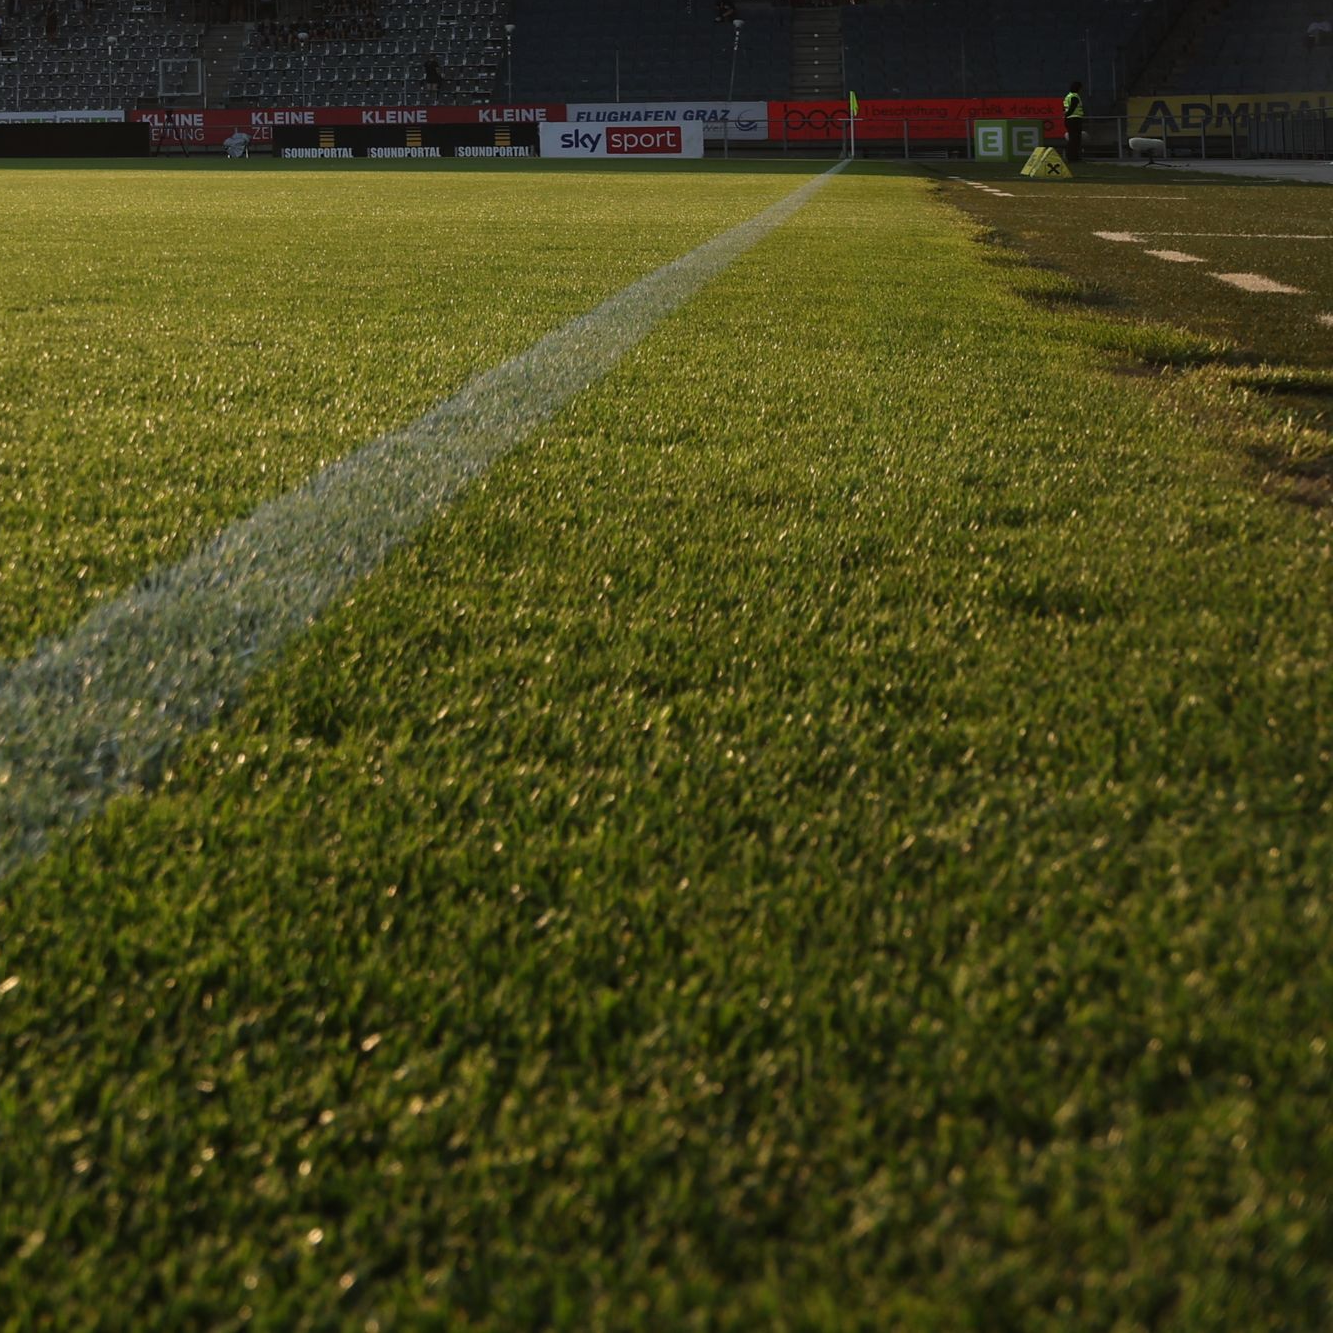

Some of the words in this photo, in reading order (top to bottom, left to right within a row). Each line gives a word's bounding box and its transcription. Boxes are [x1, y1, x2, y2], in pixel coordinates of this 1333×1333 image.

[251, 112, 315, 125] KLEINE
[362, 110, 428, 124] KLEINE
[478, 108, 547, 122] KLEINE
[576, 109, 676, 122] FLUGHAFEN
[682, 109, 731, 121] GRAZ
[1138, 97, 1326, 133] ADMIRA
[150, 128, 205, 142] EITUNG
[561, 129, 602, 153] sky
[611, 131, 677, 152] sport
[284, 148, 354, 158] SOUNDPORTAL
[370, 147, 442, 158] SOUNDPORTAL
[458, 146, 530, 157] SOUNDPORTAL
